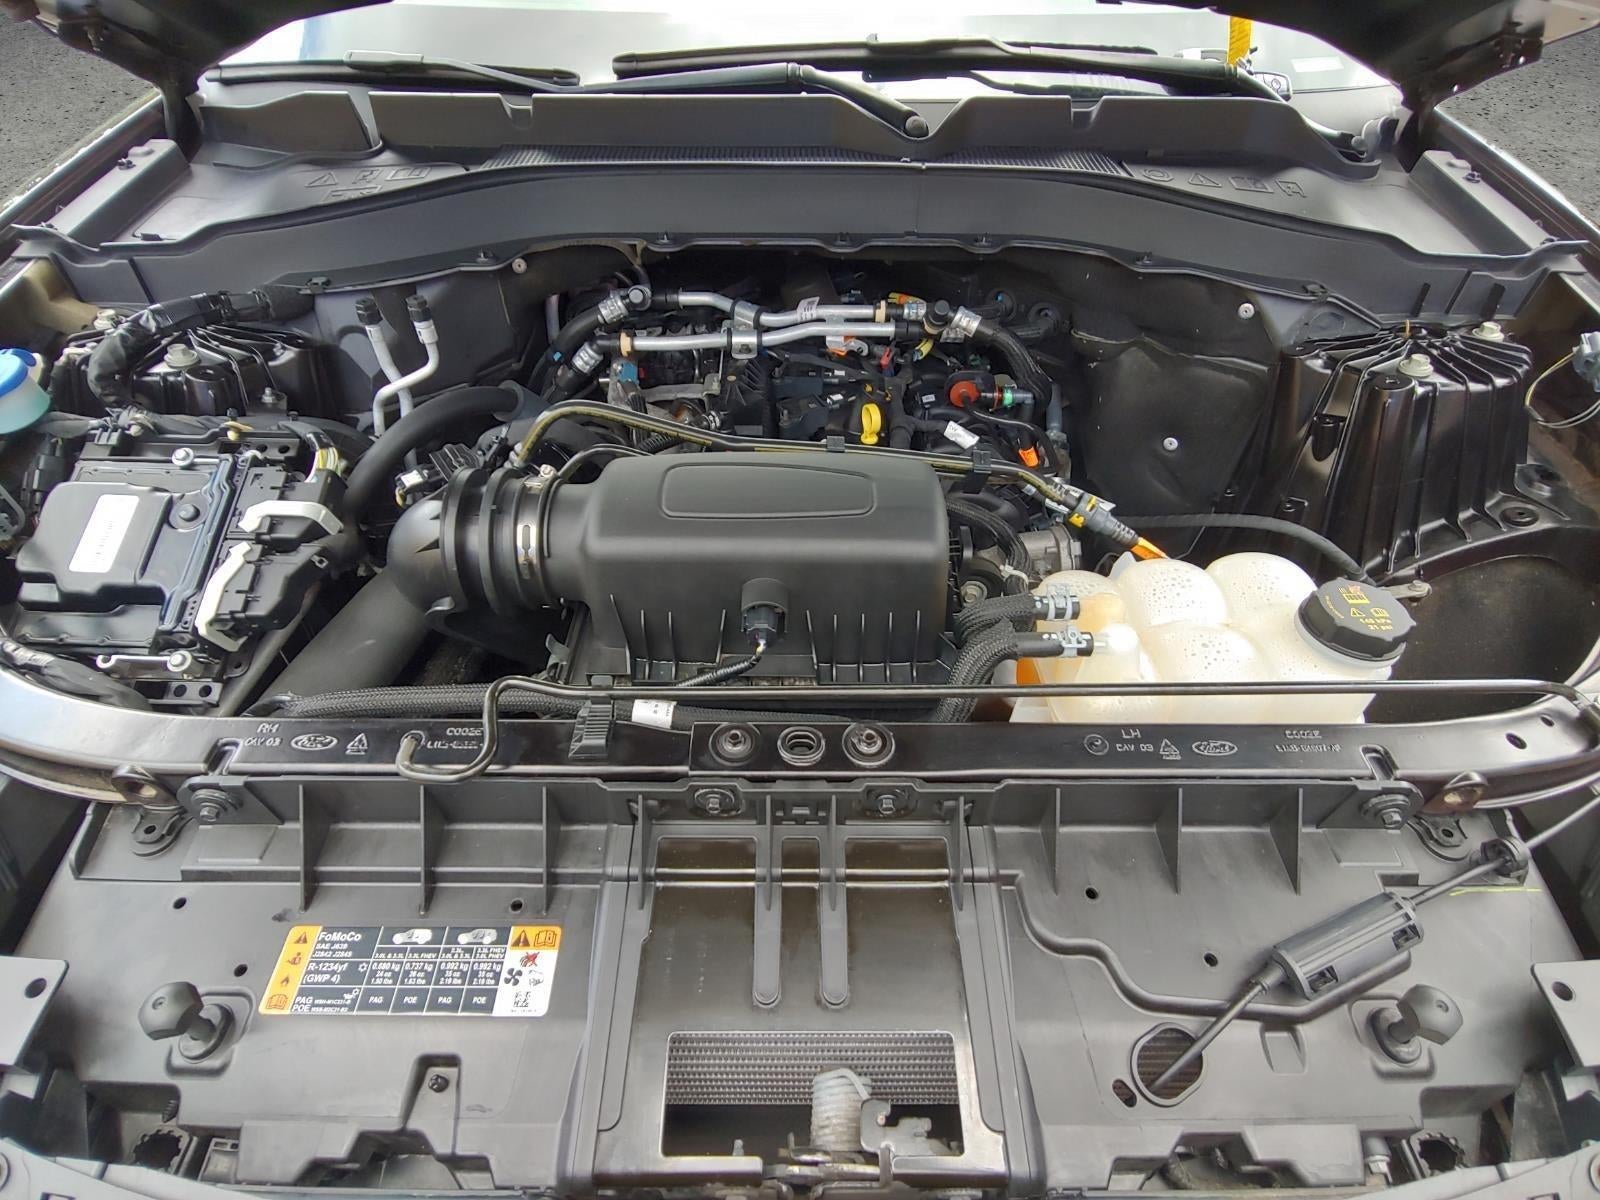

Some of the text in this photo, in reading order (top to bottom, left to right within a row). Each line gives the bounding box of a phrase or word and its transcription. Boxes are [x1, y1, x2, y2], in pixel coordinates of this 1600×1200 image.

[257, 722, 280, 733] RH
[1121, 729, 1142, 739] LH
[1115, 743, 1135, 752] CAV
[318, 931, 362, 942] FoMoCo
[307, 962, 349, 973] R-1234yf
[391, 962, 401, 972] kg
[404, 962, 434, 972] 0.737 kg
[440, 962, 469, 972] 0.992 kg
[473, 962, 502, 972] 0.992 kg
[302, 973, 341, 984] (GWP 4)
[294, 996, 313, 1004] PAG
[368, 995, 384, 1004] PAG
[403, 995, 418, 1004] POE
[437, 995, 453, 1004] PAG
[472, 995, 487, 1004] POE
[292, 1004, 311, 1012] POE
